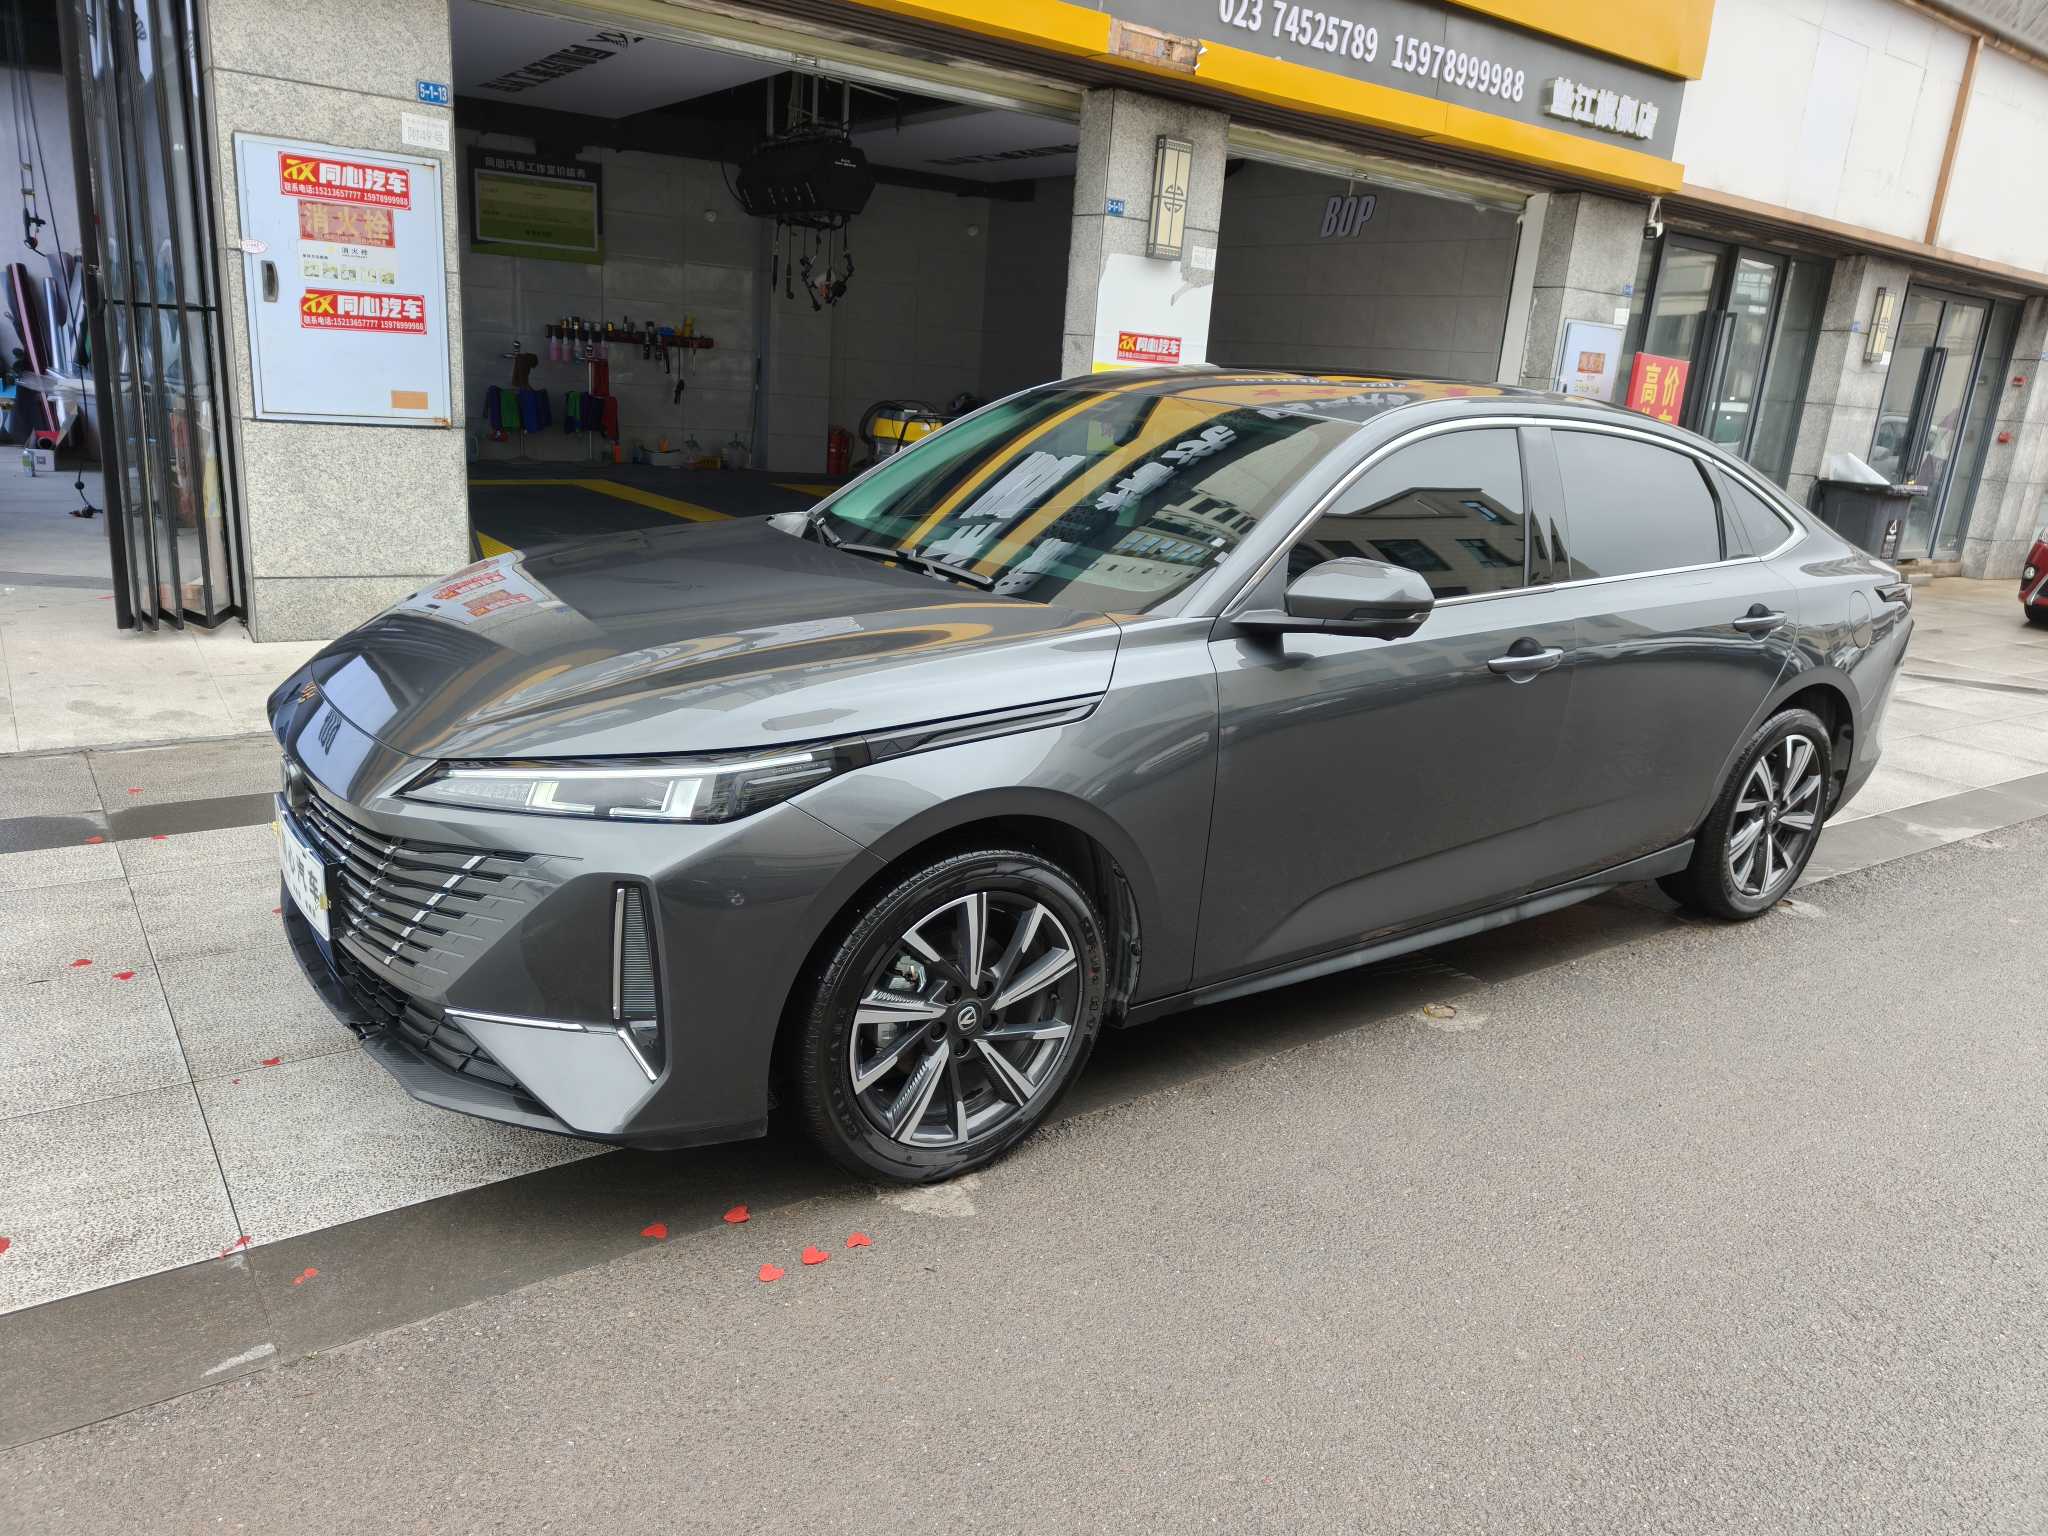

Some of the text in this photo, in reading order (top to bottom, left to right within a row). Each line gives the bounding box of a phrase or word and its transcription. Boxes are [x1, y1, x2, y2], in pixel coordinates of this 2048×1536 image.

[1219, 0, 1525, 102] 023 74525789 15978999988
[419, 83, 447, 102] 5-1-13
[319, 163, 407, 194] 同心汽车
[303, 204, 389, 241] 消火栓
[337, 294, 423, 319] 同心汽车
[1640, 362, 1680, 407] 高价
